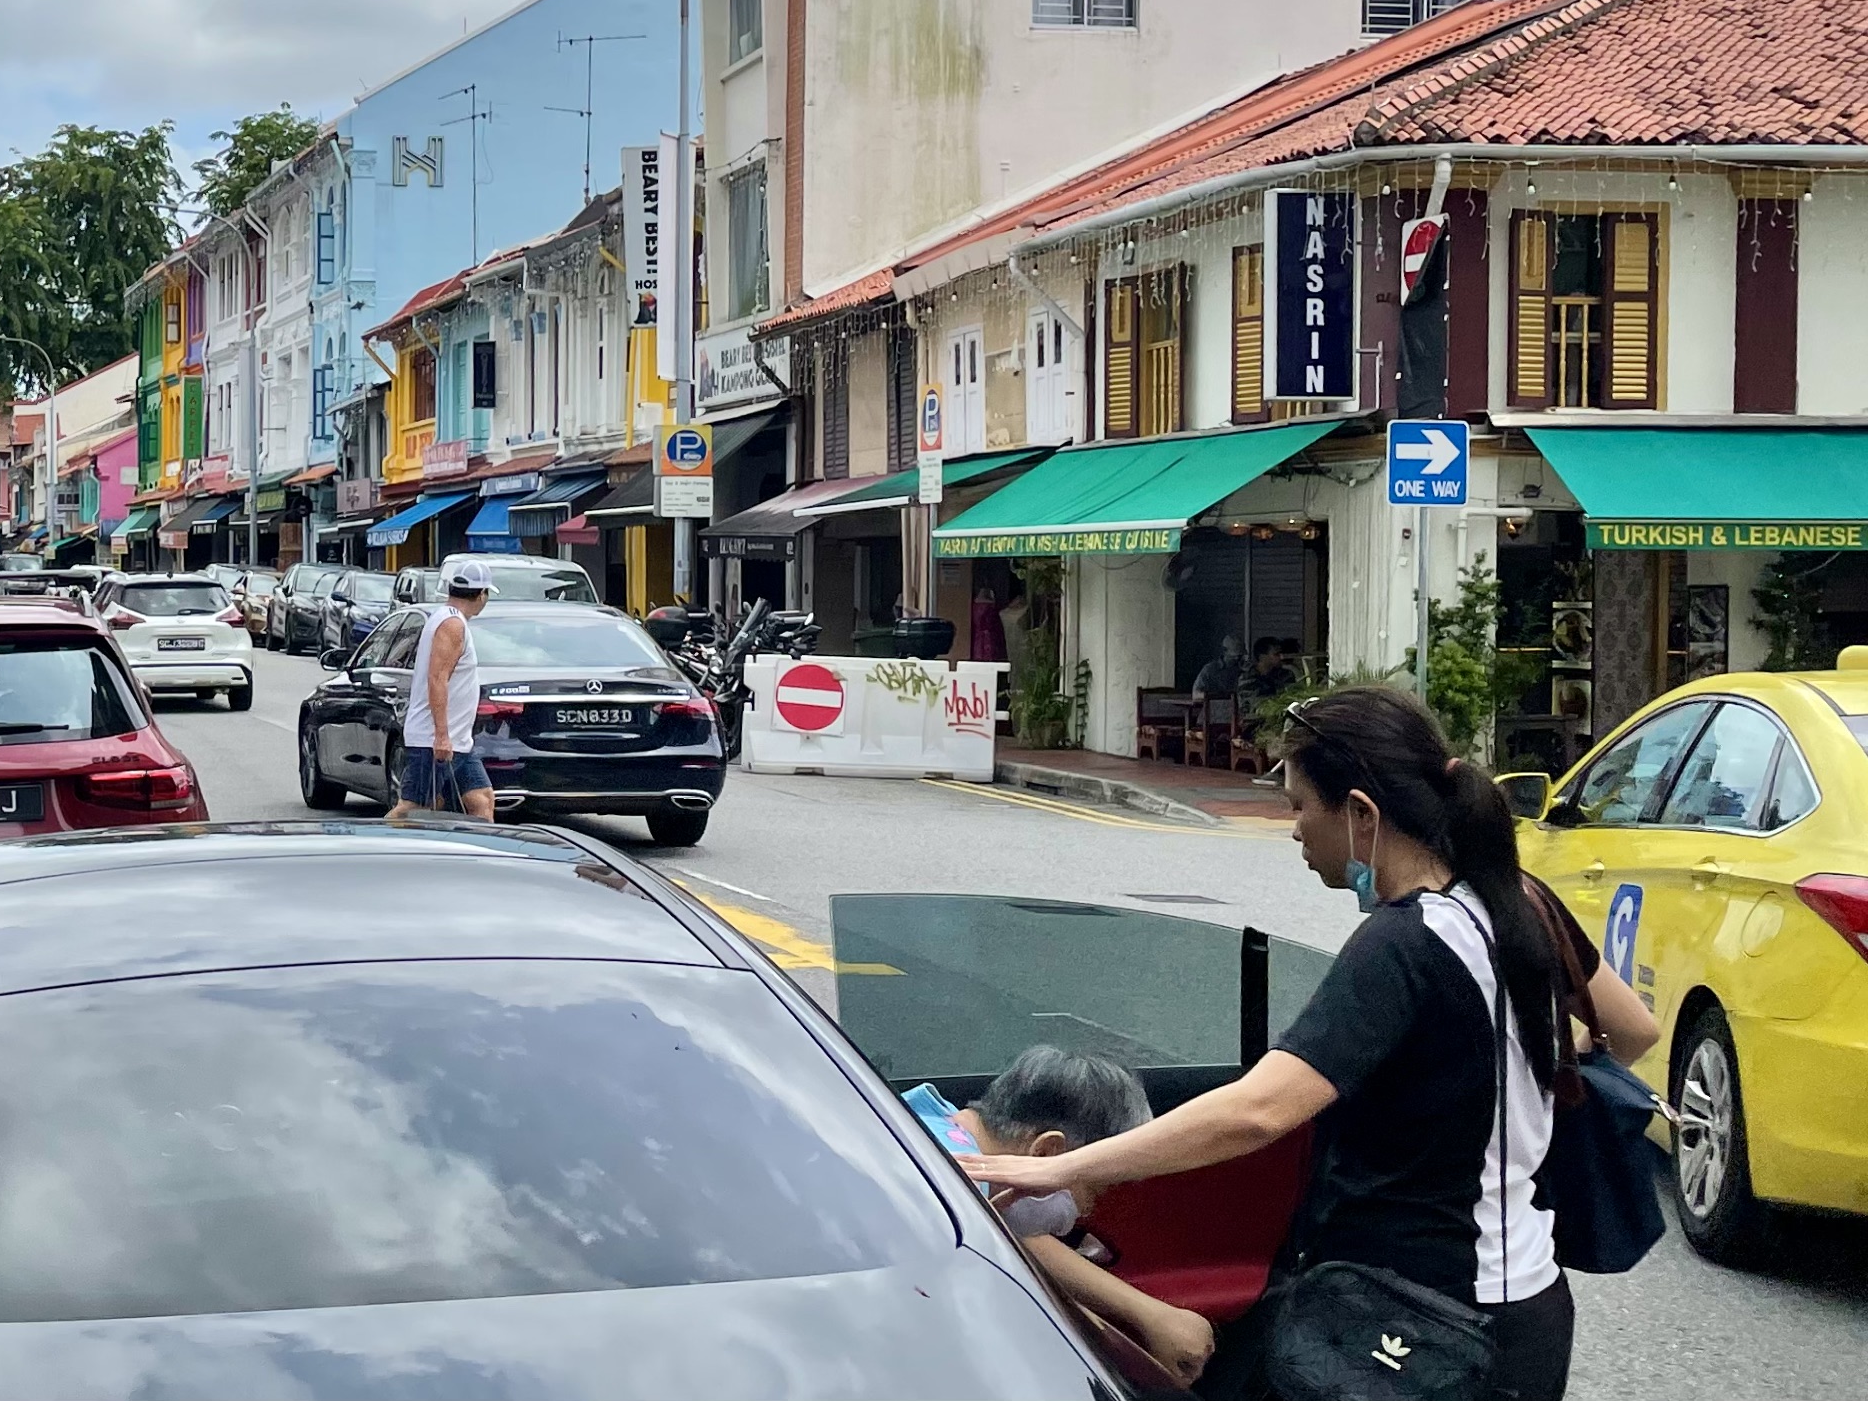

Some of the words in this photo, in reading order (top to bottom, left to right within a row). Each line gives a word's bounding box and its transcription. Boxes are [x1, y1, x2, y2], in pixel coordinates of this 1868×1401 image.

[642, 150, 658, 216] BEARY
[635, 280, 658, 290] HOS
[1305, 196, 1324, 394] NASRIN
[1394, 480, 1425, 498] ONE
[1431, 480, 1461, 498] WAY
[1599, 524, 1703, 546] TURKISH
[1710, 523, 1728, 546] &
[1735, 523, 1862, 546] LEBANESE
